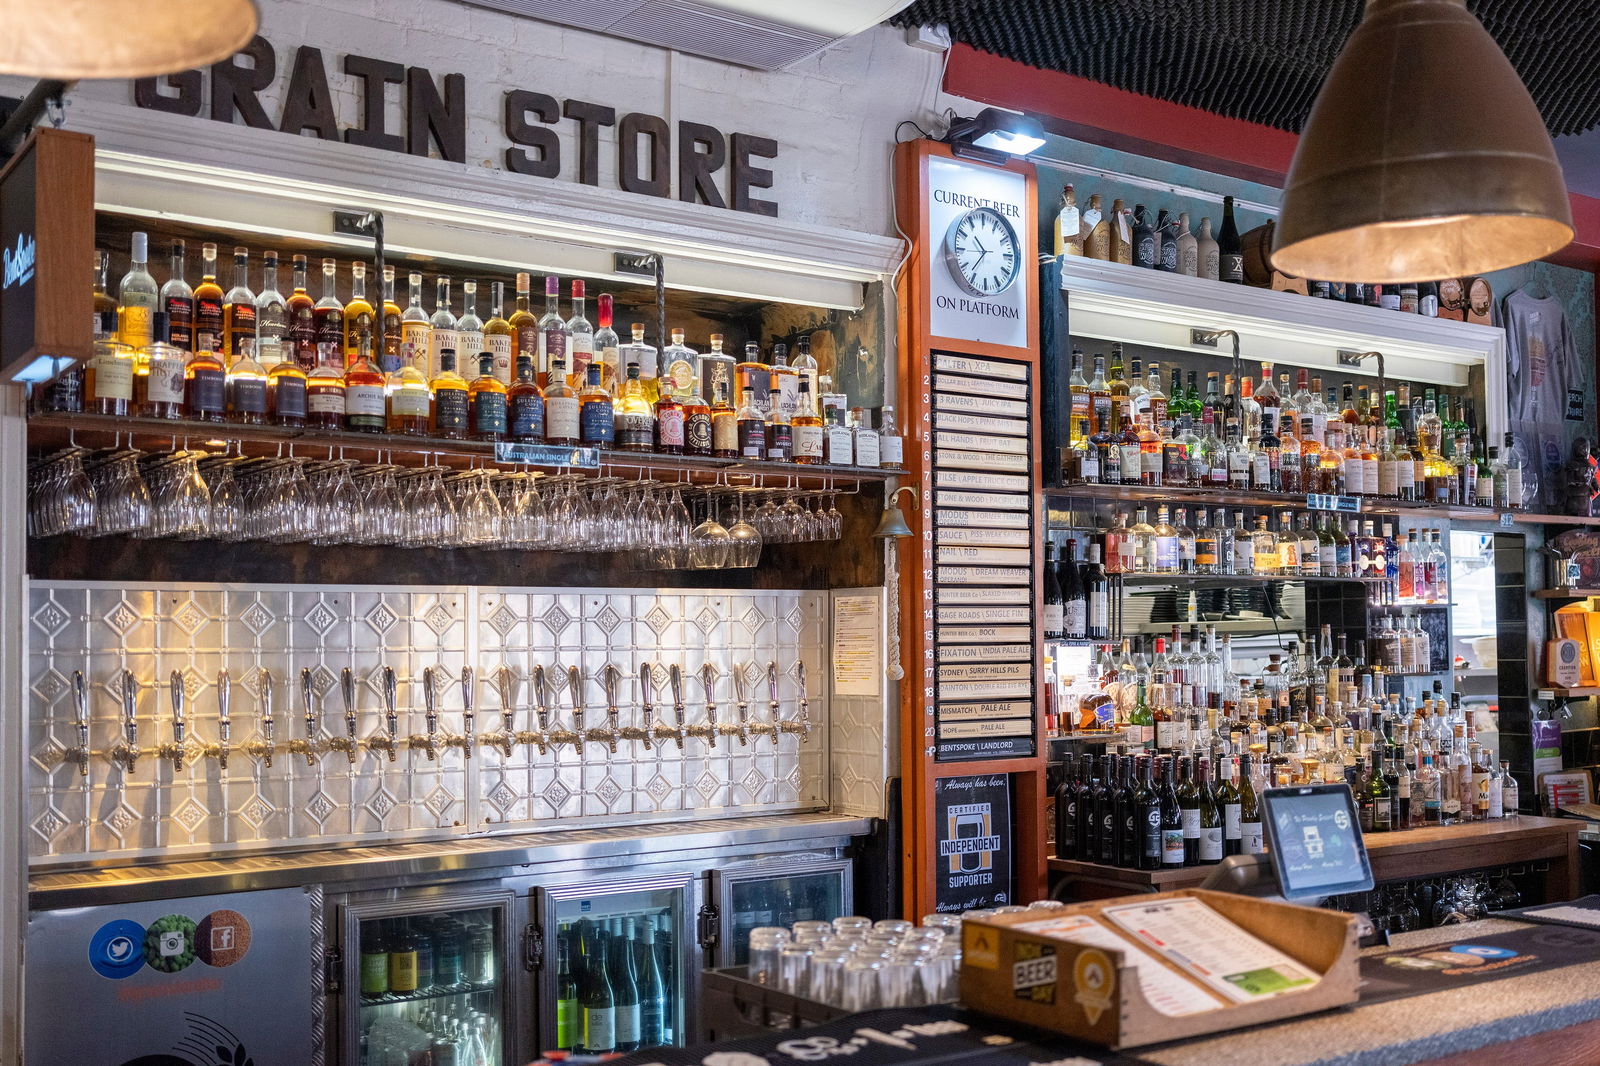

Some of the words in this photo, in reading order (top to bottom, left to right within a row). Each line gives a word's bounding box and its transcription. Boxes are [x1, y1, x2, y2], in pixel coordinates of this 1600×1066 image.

[134, 33, 466, 164] GRAIN
[505, 89, 779, 217] STORE
[934, 189, 990, 208] CURRENT
[993, 202, 1020, 218] BEER
[936, 296, 956, 310] ON
[960, 299, 1020, 319] PLATFORM
[975, 361, 991, 371] XPA
[923, 375, 929, 385] 2
[923, 394, 929, 404] 3
[946, 396, 973, 405] RAVENS
[982, 399, 999, 408] JUICY
[923, 413, 929, 423] 4
[937, 414, 957, 423] BLACK
[958, 416, 974, 424] HOPS
[923, 432, 930, 442] 5
[938, 434, 949, 442] ALL
[979, 437, 997, 446] FRUIT
[503, 451, 545, 461] AUSTRALIAN
[924, 451, 930, 460] 6
[924, 471, 930, 480] 7
[962, 475, 983, 483] APPLE
[984, 476, 1005, 484] TRUCK
[924, 490, 930, 500] 8
[924, 509, 930, 518] 9
[940, 511, 968, 519] MODUS
[923, 531, 932, 540] 10
[940, 531, 962, 539] SAUCE
[923, 549, 932, 558] 11
[940, 548, 958, 556] NAIL
[923, 569, 932, 580] 12
[940, 567, 968, 575] MODUS
[924, 589, 933, 600] 13
[924, 609, 933, 619] 14
[940, 611, 957, 619] GAGE
[959, 611, 981, 619] ROADS
[986, 610, 1011, 618] SINGLE
[1012, 609, 1023, 617] FIN
[924, 630, 933, 640] 15
[924, 649, 934, 659] 16
[940, 648, 977, 657] FIXATION
[1002, 646, 1017, 654] PALE
[1018, 646, 1029, 654] ALE
[924, 667, 934, 678] 17
[969, 667, 989, 675] SURRY
[924, 687, 934, 697] 18
[940, 684, 969, 692] DAINTON
[925, 706, 934, 715] 19
[940, 707, 973, 715] MISMATCH
[981, 704, 998, 712] PALE
[999, 703, 1011, 711] ALE
[925, 727, 935, 737] 20
[940, 743, 976, 752] BENTSPOKE
[980, 741, 1014, 750] LANDLORD
[944, 778, 974, 791] Always
[974, 777, 988, 788] has
[949, 804, 991, 814] CERTIFIED
[941, 836, 1000, 854] INDEPENDENT
[949, 872, 993, 888] SUPPORTER
[936, 901, 961, 913] Always
[963, 898, 978, 909] will
[1016, 959, 1056, 985] BEER
